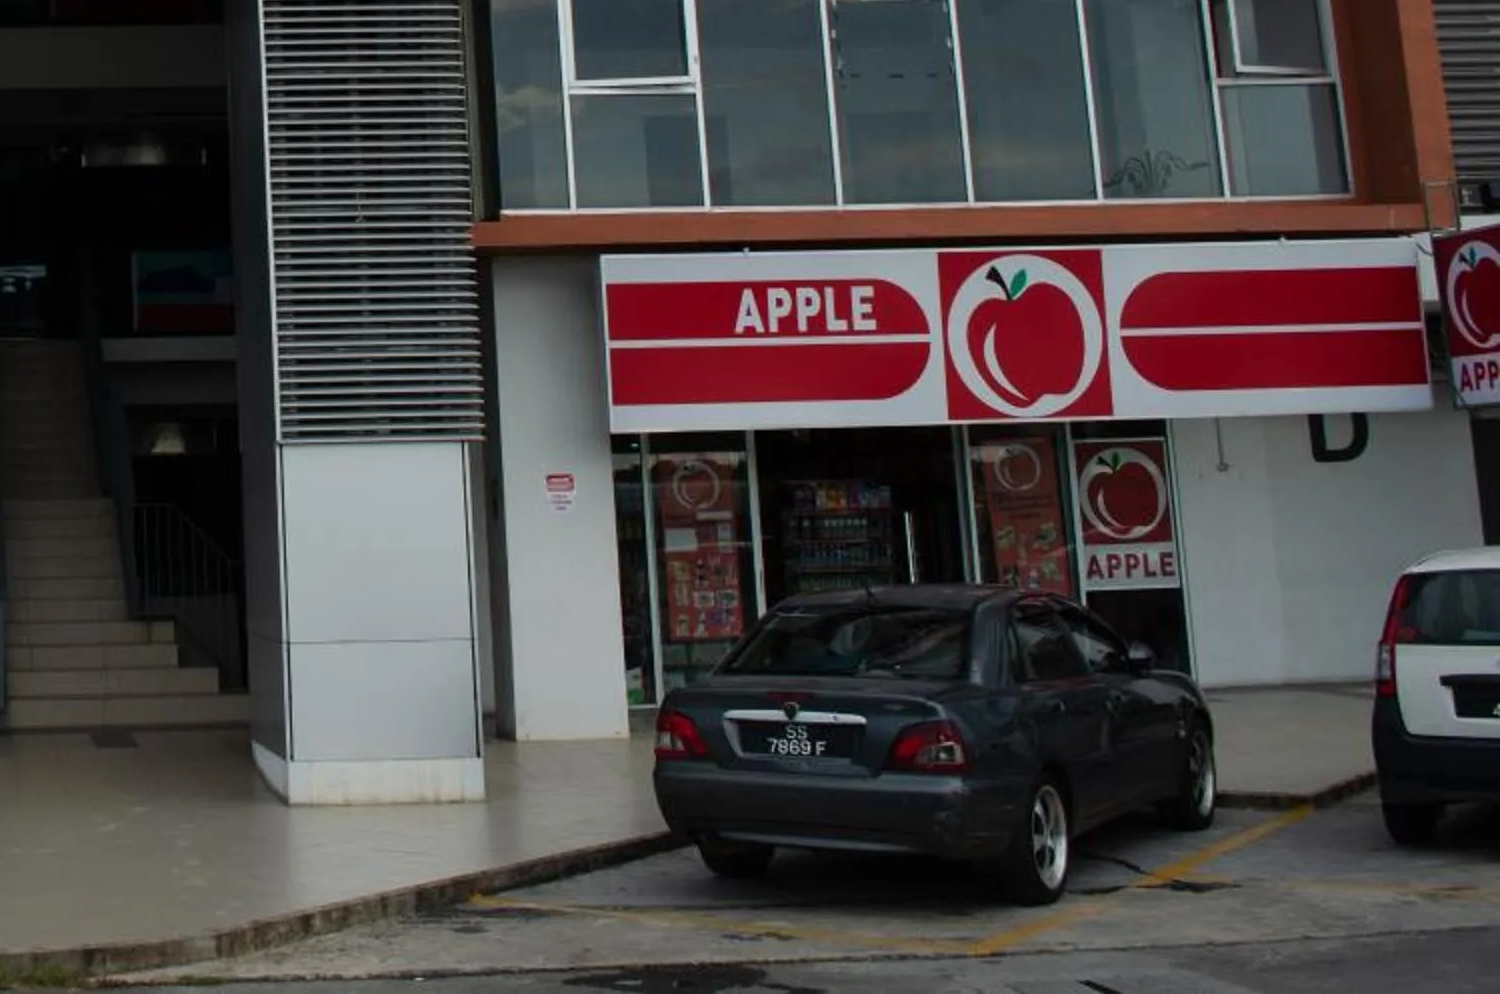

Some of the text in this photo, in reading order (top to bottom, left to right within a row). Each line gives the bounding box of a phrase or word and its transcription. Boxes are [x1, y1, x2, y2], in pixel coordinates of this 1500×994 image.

[734, 285, 878, 334] APPLE
[1459, 360, 1500, 392] APP
[1086, 552, 1176, 580] APPLE
[784, 724, 808, 740] SS
[815, 741, 828, 756] F
